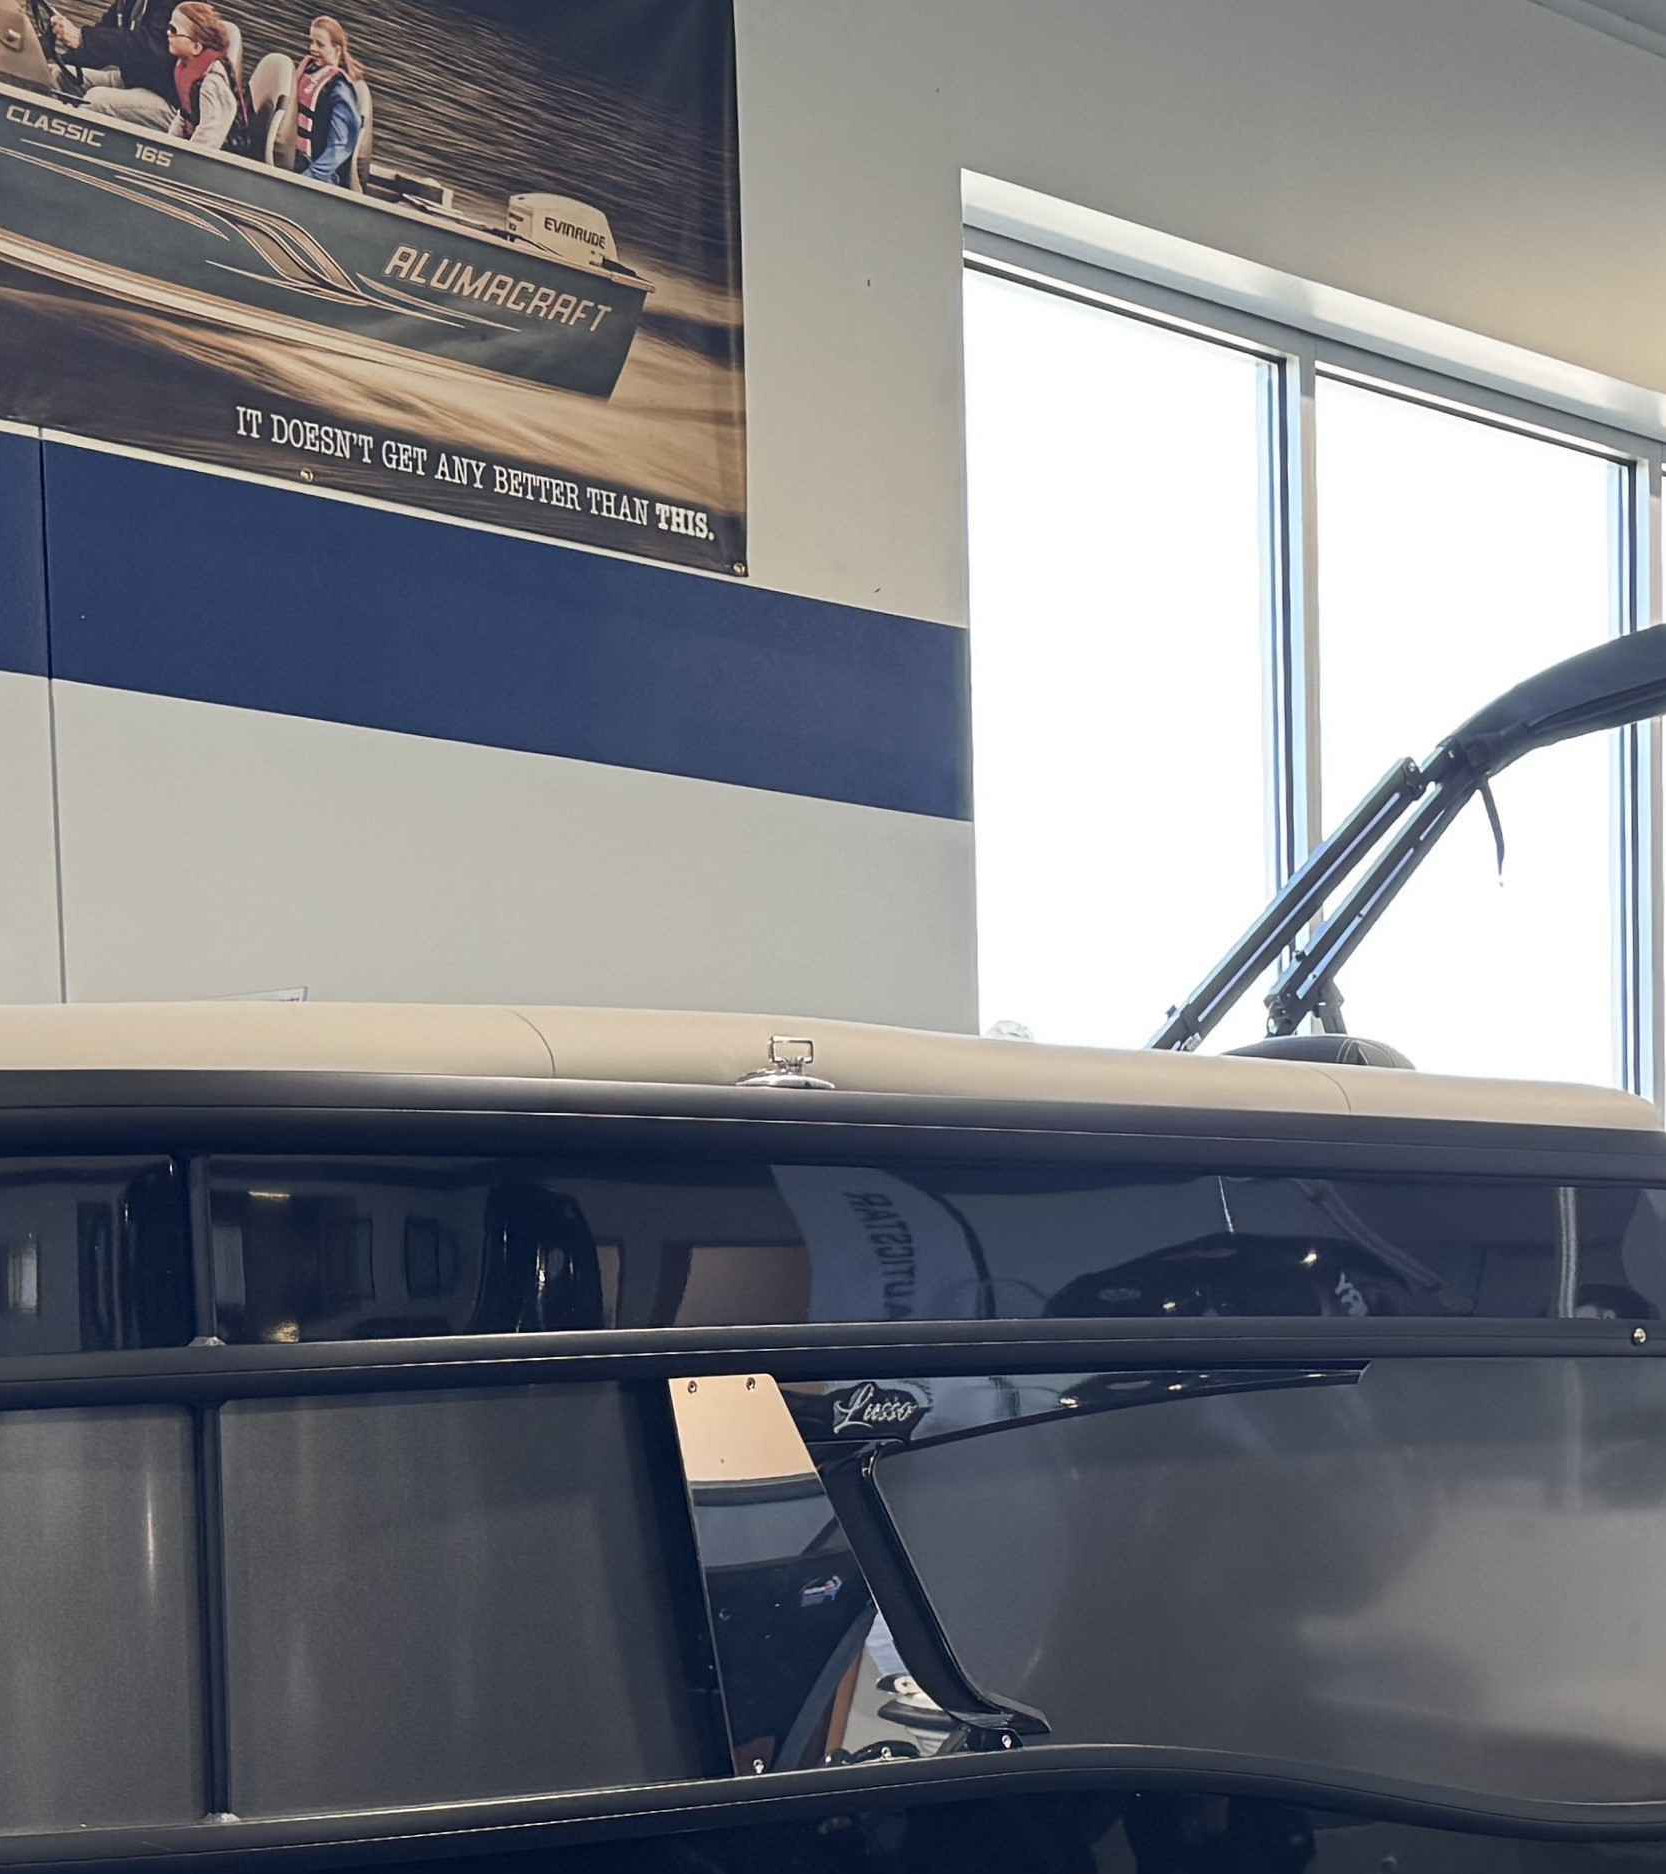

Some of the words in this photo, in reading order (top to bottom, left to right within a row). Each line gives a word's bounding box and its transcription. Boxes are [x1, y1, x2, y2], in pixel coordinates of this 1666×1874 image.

[6, 105, 105, 147] CLASSIC
[135, 142, 175, 168] 165
[543, 216, 608, 249] EVINRUDE
[384, 246, 613, 333] ALUMACRAFT
[236, 406, 263, 439] IT
[270, 413, 374, 464] DOESN'T
[381, 440, 428, 476] GET
[434, 453, 487, 489] ANY
[493, 465, 582, 512] BETTER
[586, 487, 649, 526] THAN
[655, 502, 716, 542] THIS.
[833, 1383, 918, 1435] Lusso
